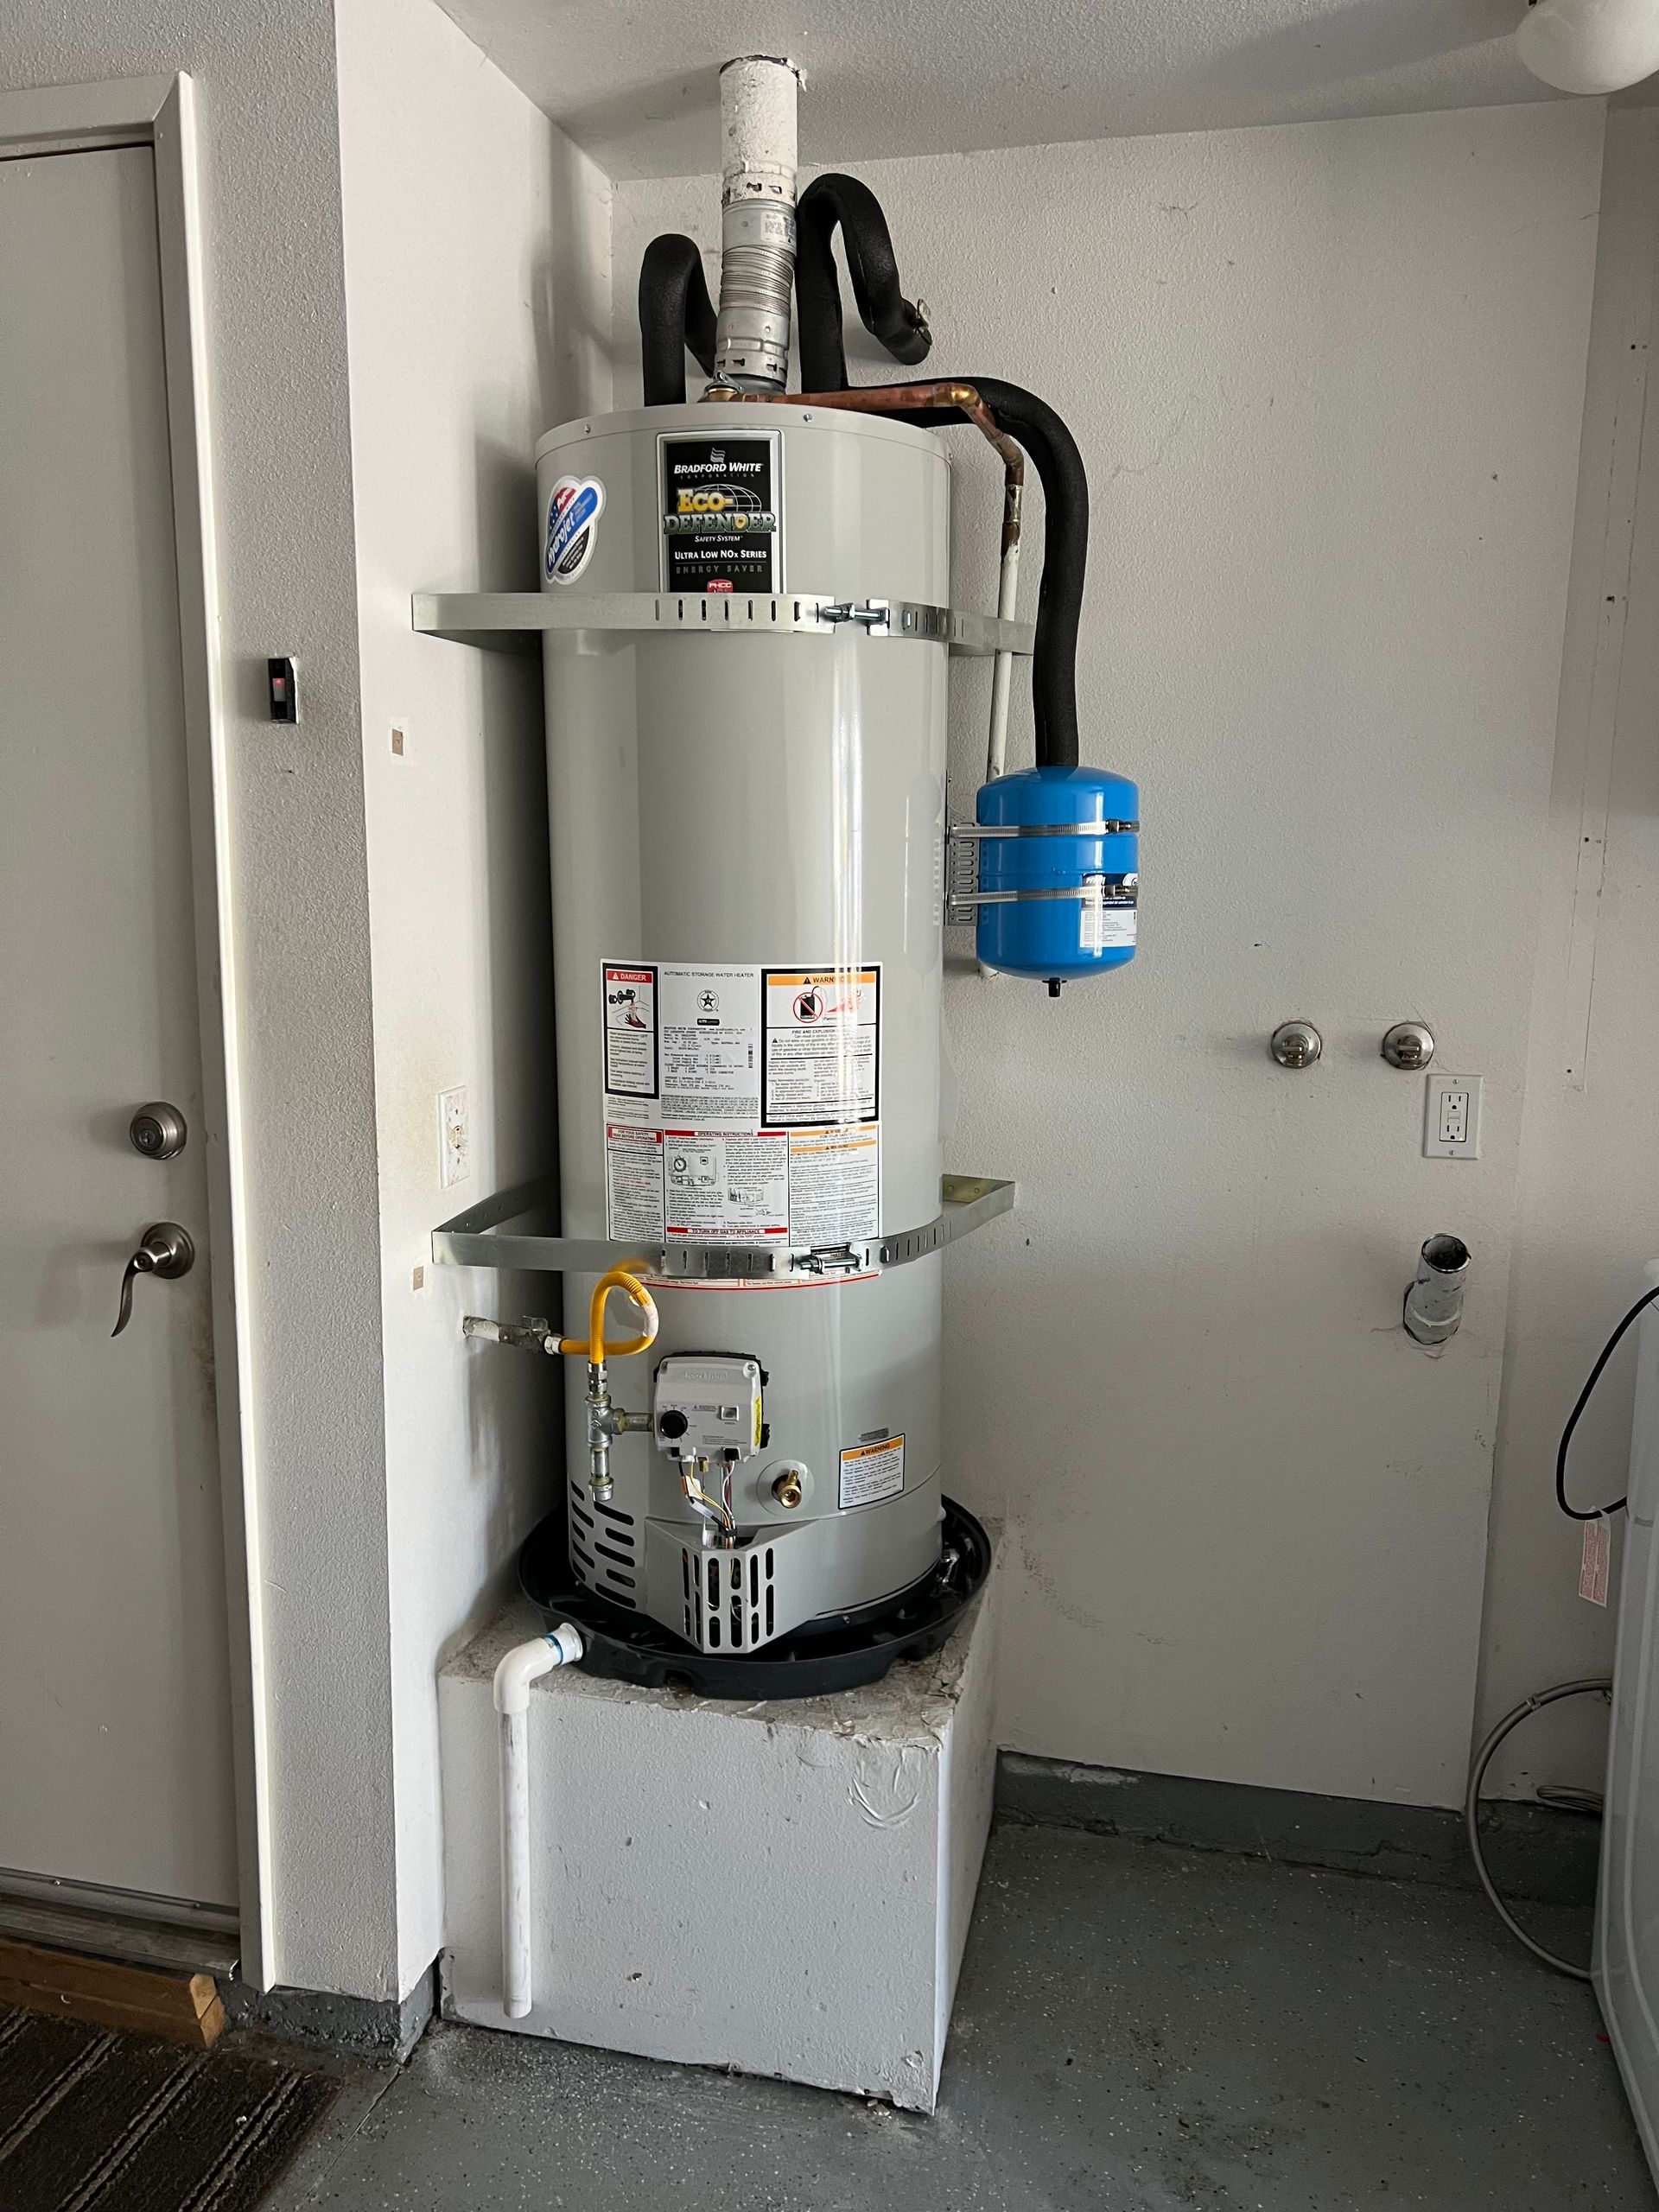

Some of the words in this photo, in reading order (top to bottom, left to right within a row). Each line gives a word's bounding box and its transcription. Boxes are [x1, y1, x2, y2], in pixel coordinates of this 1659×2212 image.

[674, 464, 728, 474] BRADFORD
[728, 462, 762, 472] WHITE
[664, 512, 777, 534] DEFENDER
[675, 550, 699, 560] ULTRA
[701, 550, 718, 559] LOW
[741, 550, 767, 559] SERIES
[676, 564, 720, 575] ENERGY
[727, 564, 764, 573] SAVER
[620, 973, 647, 982] DANGER
[865, 1443, 891, 1455] WARNING
